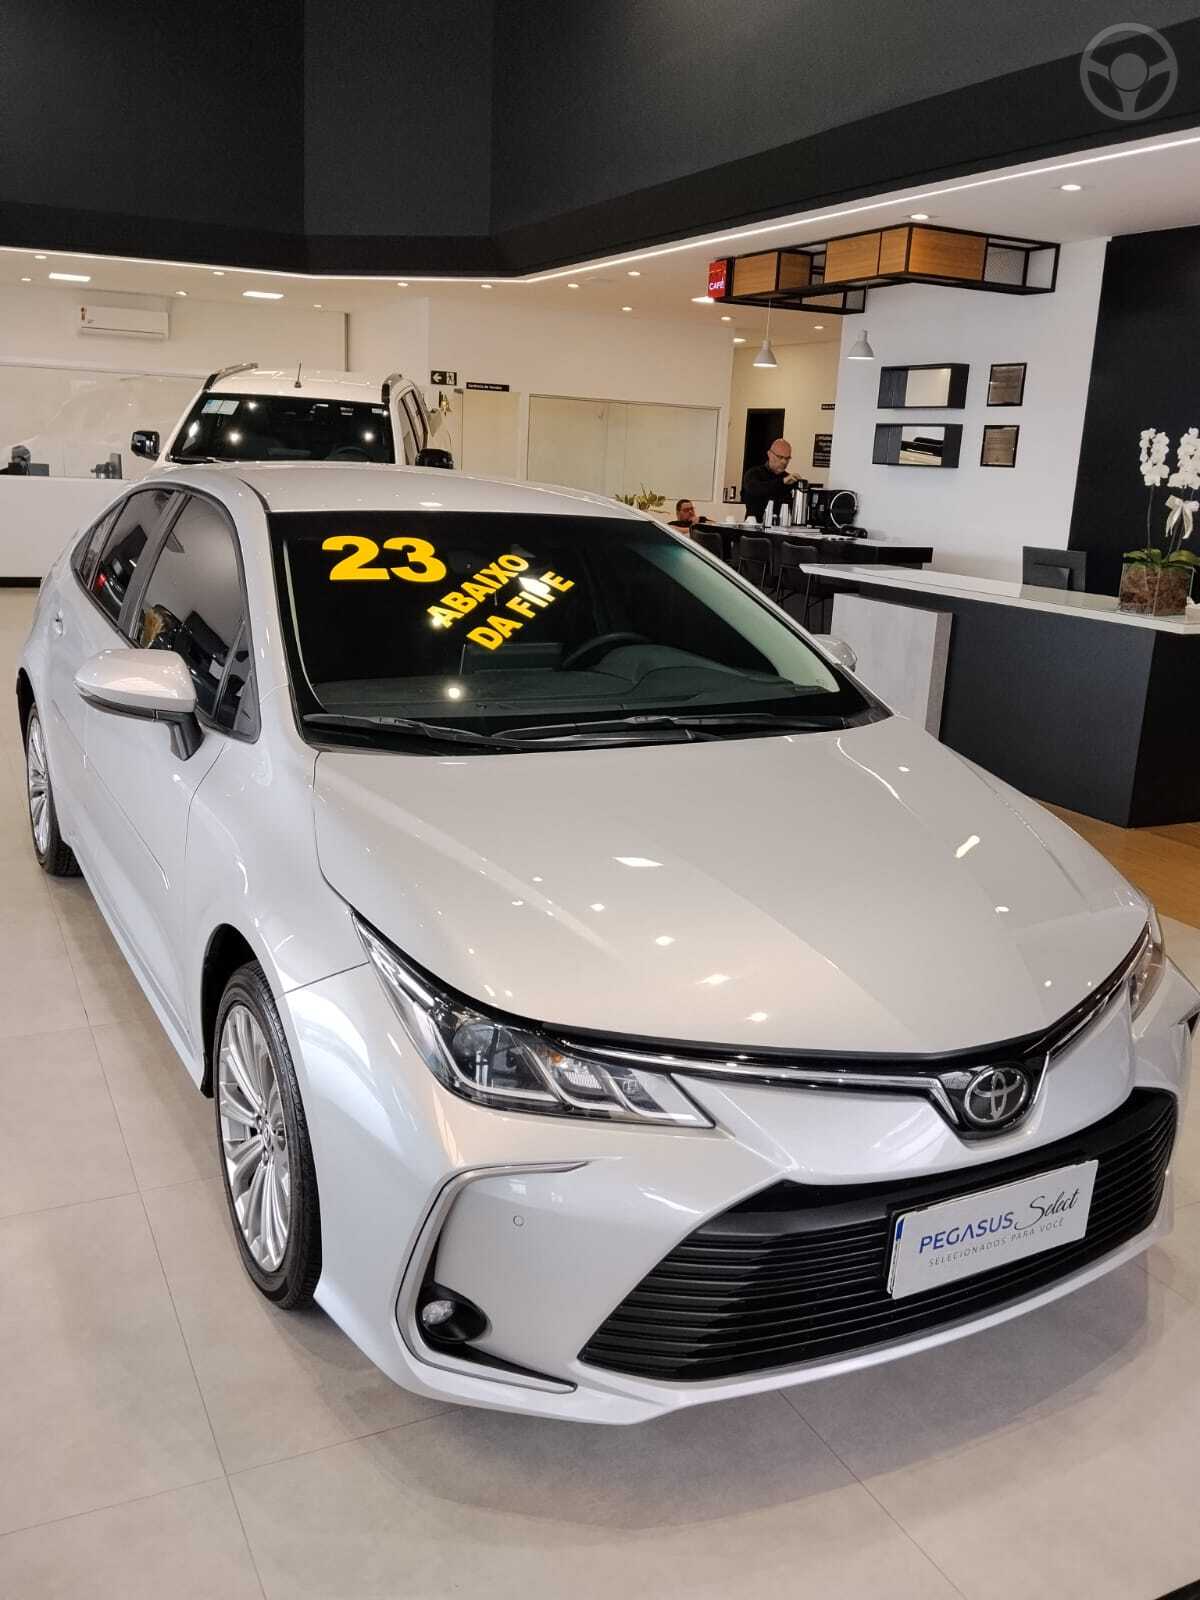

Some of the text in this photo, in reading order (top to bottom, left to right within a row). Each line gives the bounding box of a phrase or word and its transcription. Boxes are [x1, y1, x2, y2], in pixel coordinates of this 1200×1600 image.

[321, 535, 447, 583] 23
[426, 554, 529, 628] ABAIXO
[466, 615, 523, 650] DA
[918, 1188, 1080, 1254] PEGASUS Select
[928, 1237, 1006, 1267] SELECIONADOS
[1011, 1228, 1035, 1242] PARA
